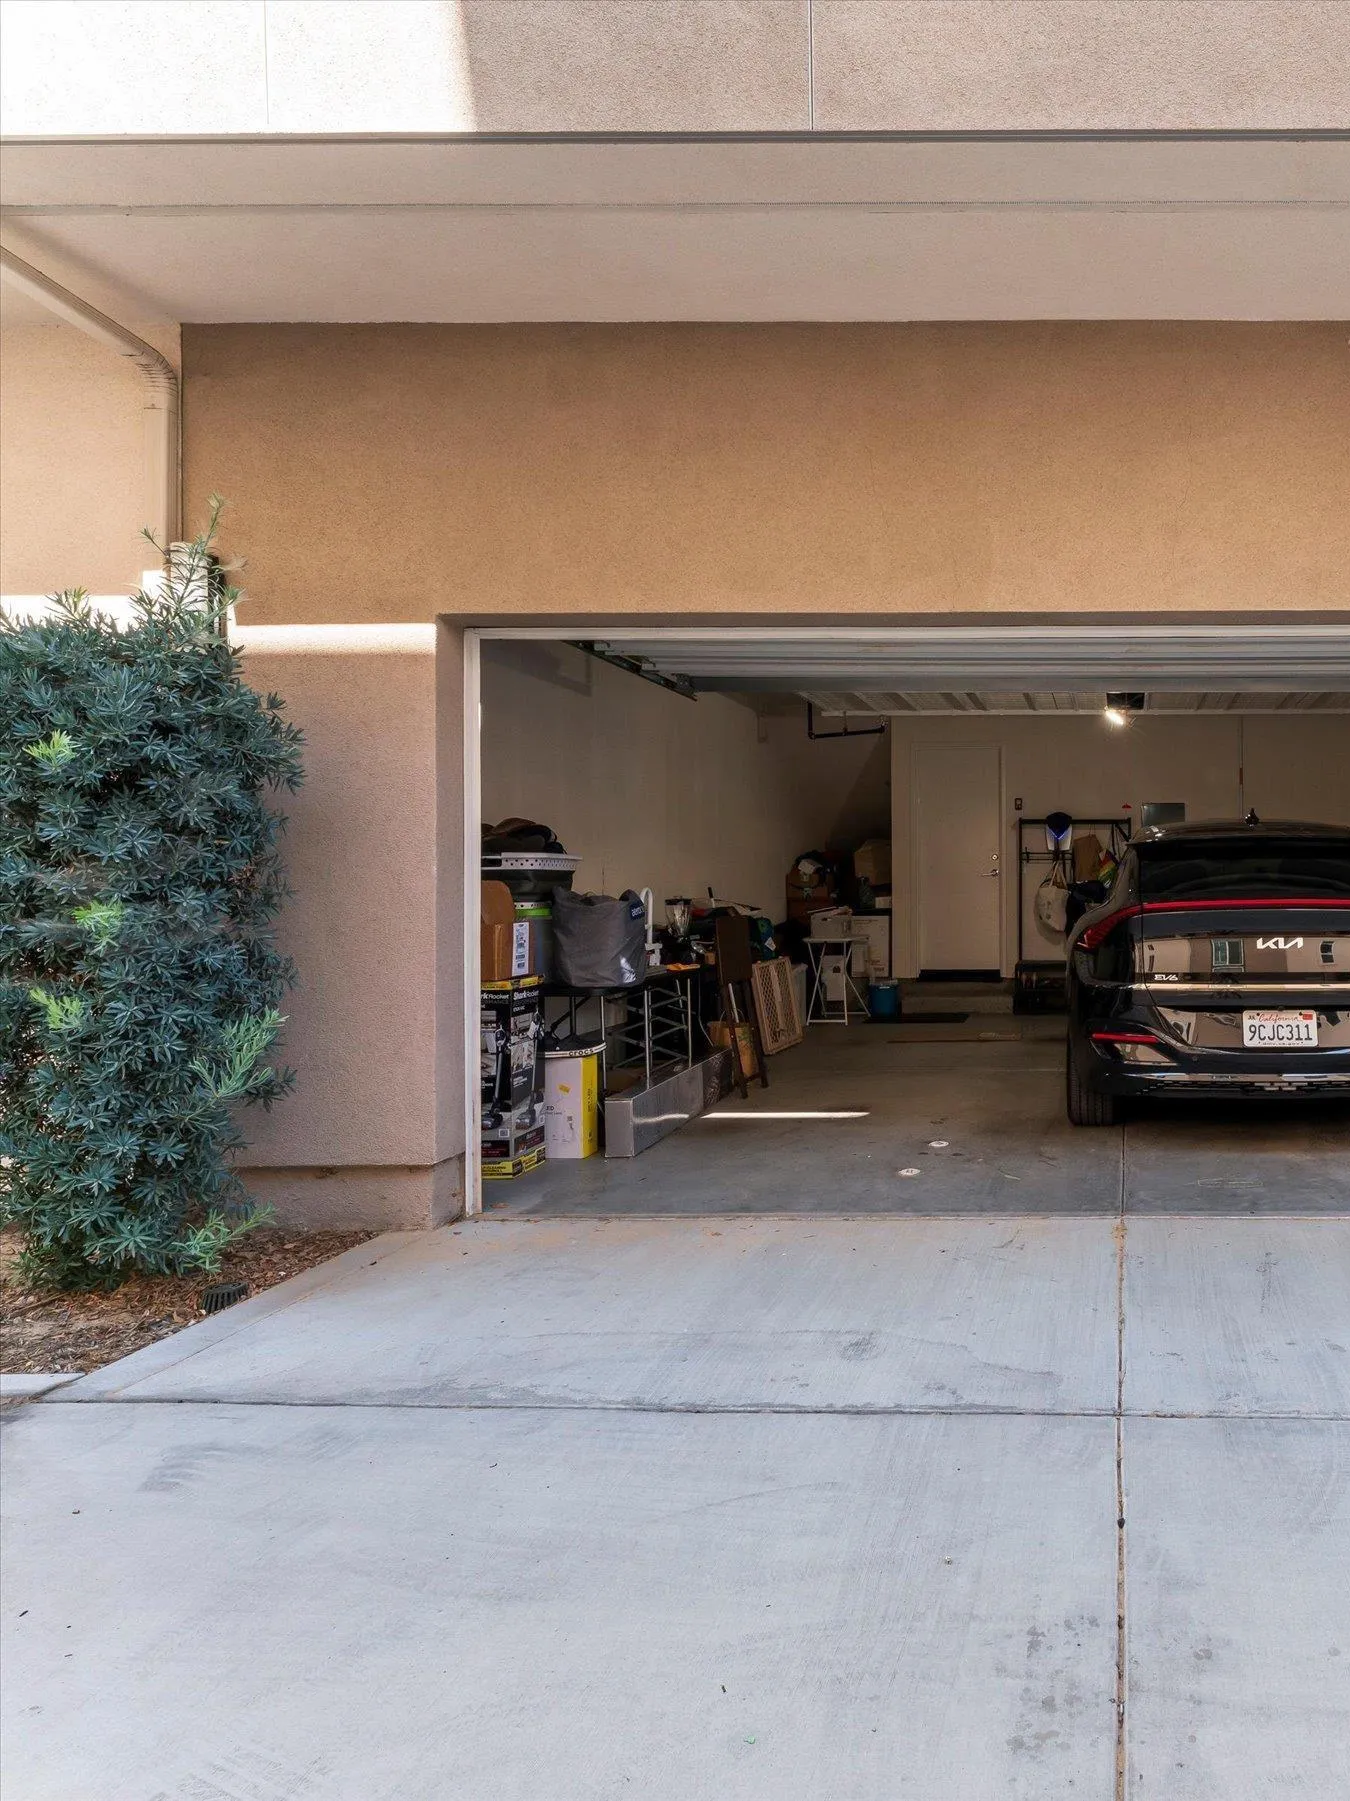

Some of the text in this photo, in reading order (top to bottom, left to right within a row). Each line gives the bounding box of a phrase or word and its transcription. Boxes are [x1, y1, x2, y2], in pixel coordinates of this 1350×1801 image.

[1256, 937, 1304, 950] KIA
[1258, 1012, 1300, 1024] California
[1248, 1023, 1314, 1041] 9CJC311
